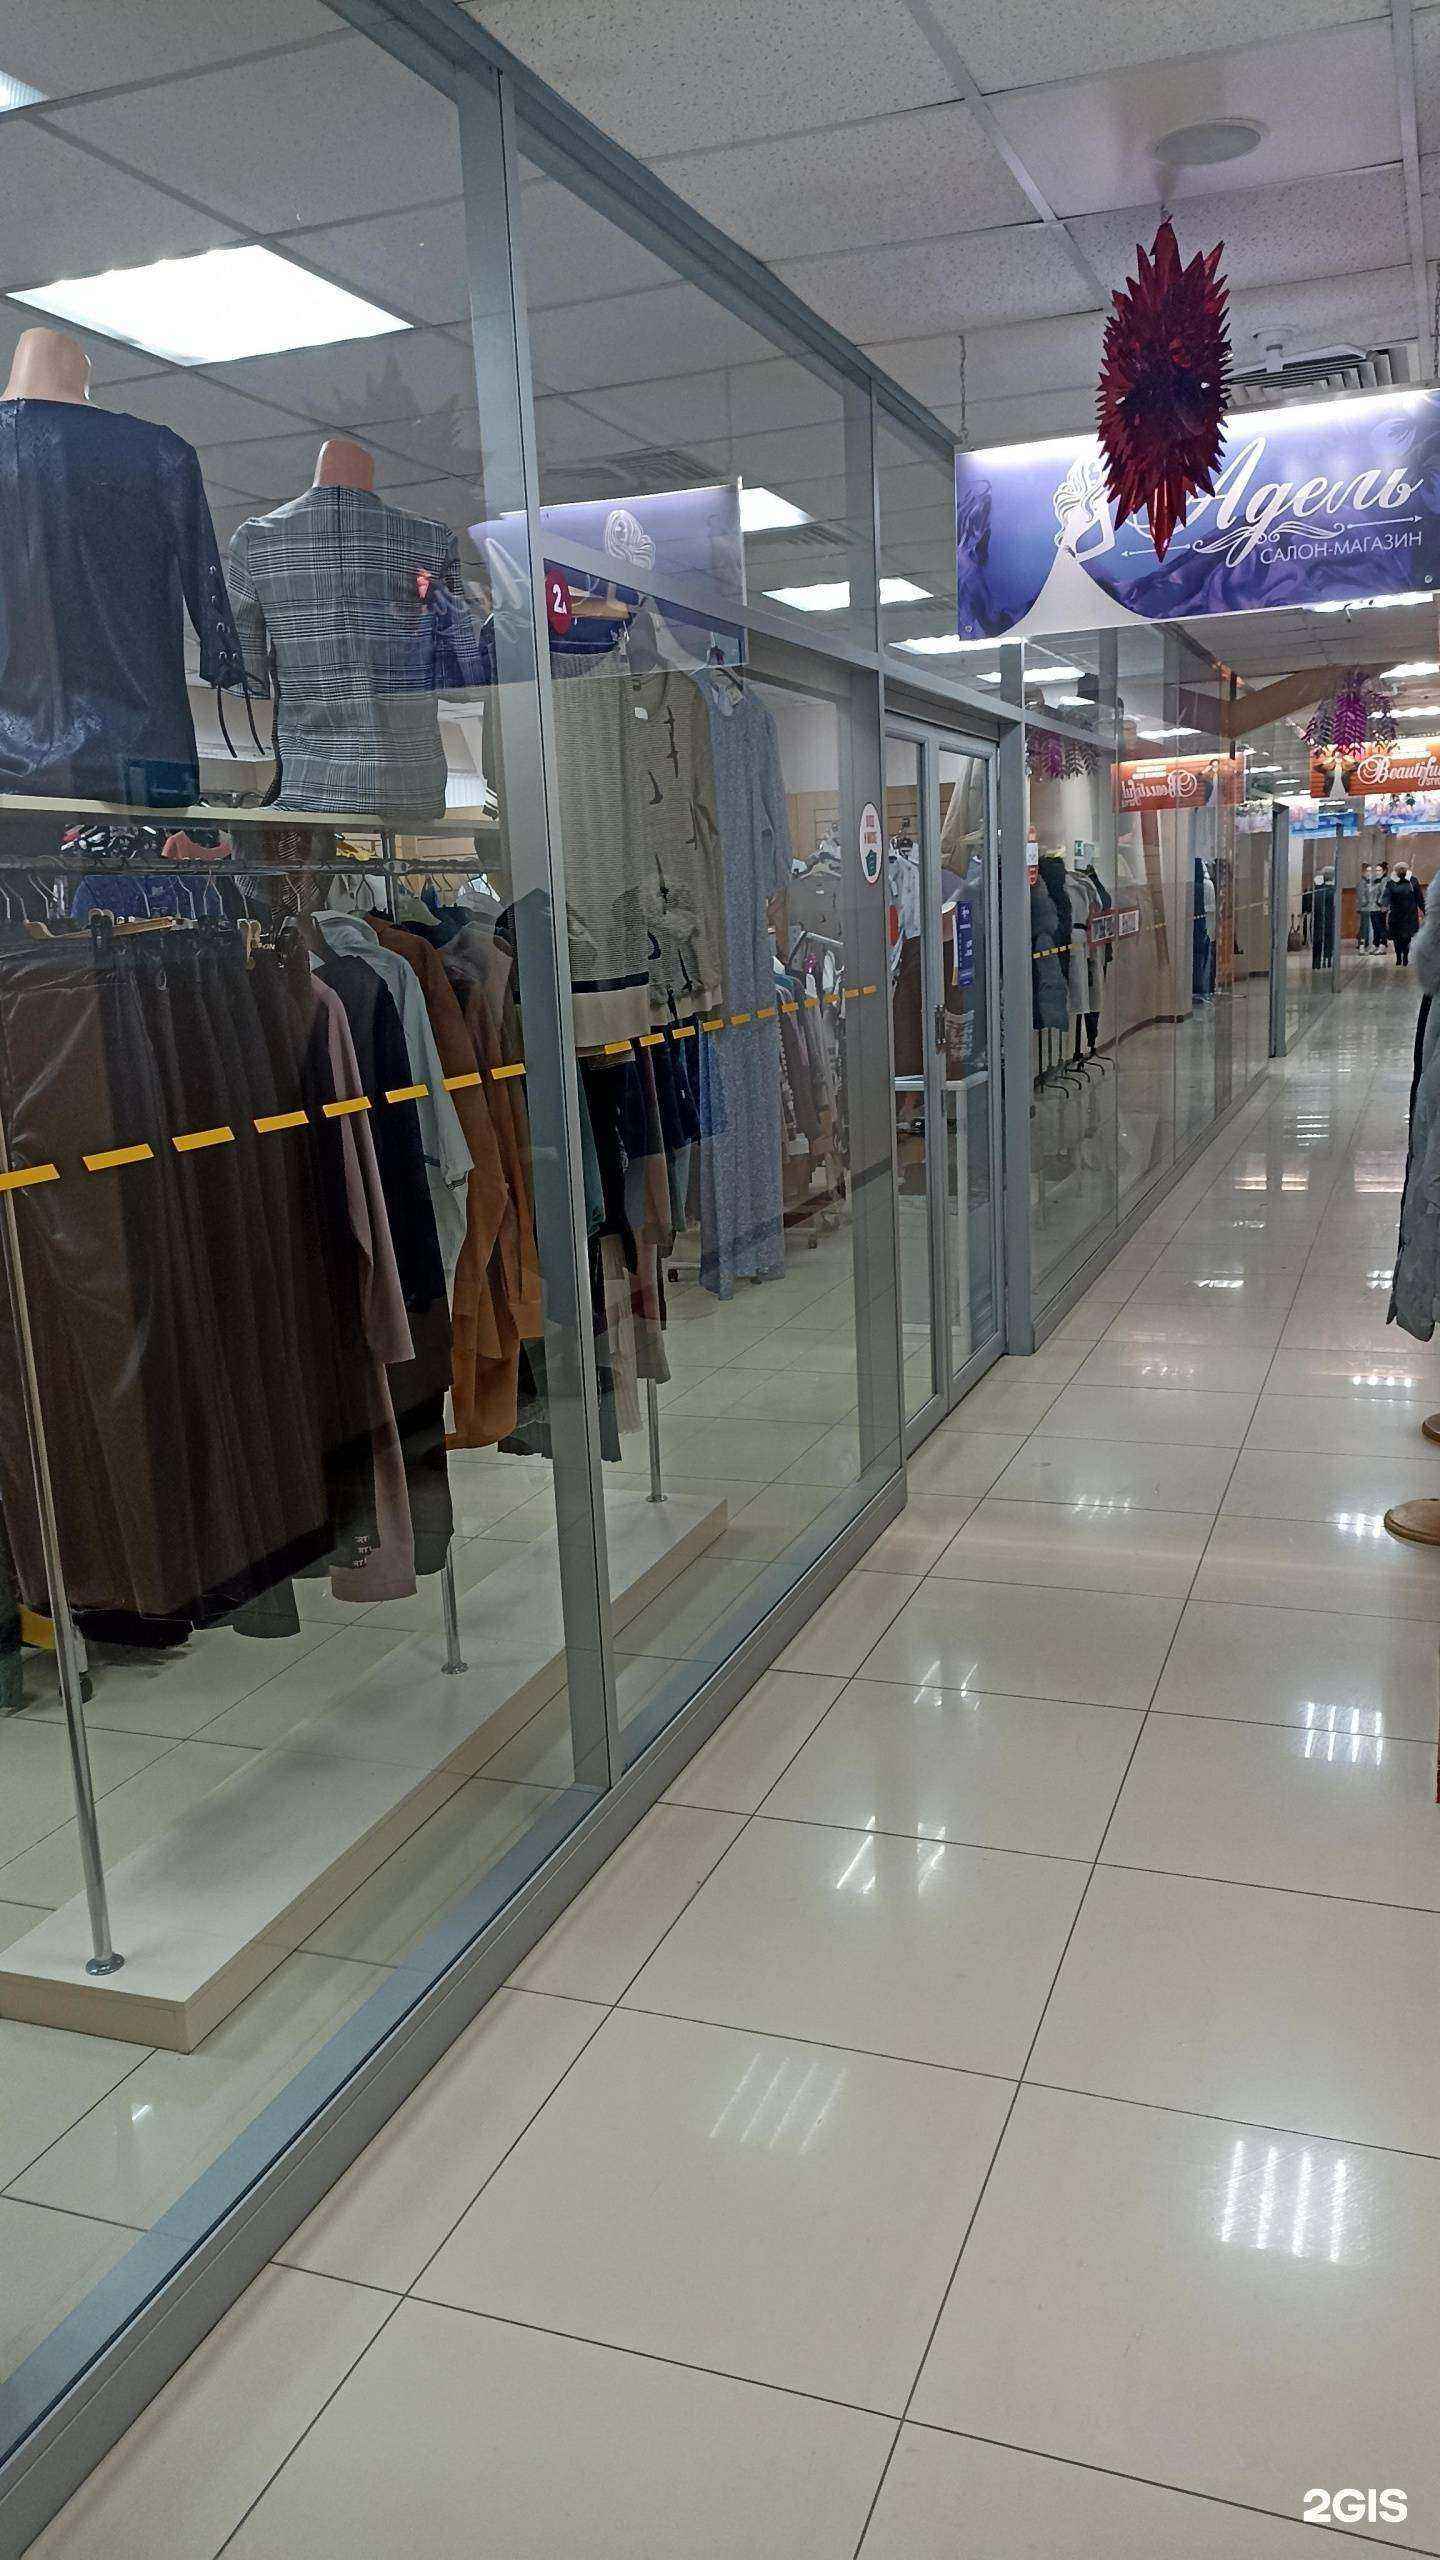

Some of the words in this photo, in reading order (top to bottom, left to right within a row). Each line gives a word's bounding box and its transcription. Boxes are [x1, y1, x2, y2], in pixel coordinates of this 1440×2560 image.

[1126, 436, 1424, 568] Адель
[1260, 531, 1423, 565] САЛОН-МАГАЗИН
[552, 583, 568, 615] 2
[1357, 754, 1440, 786] Beautifu
